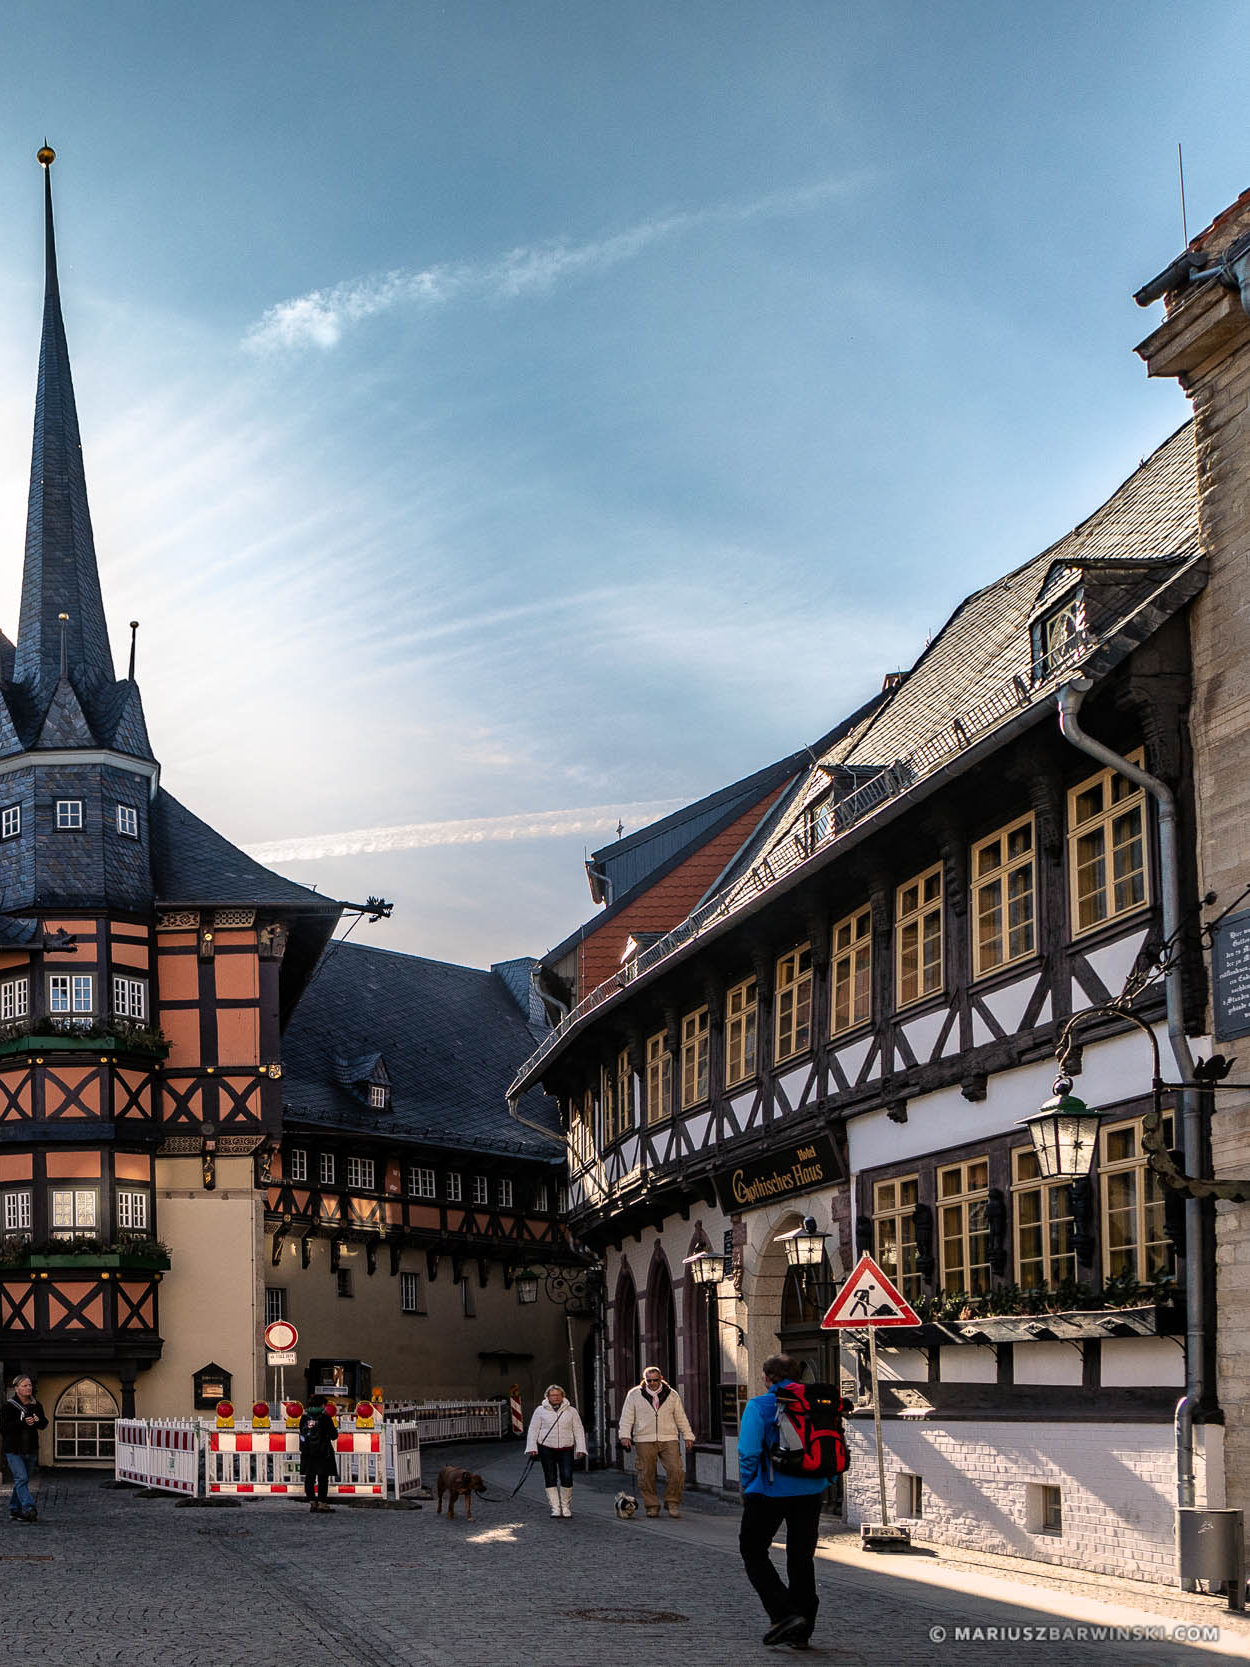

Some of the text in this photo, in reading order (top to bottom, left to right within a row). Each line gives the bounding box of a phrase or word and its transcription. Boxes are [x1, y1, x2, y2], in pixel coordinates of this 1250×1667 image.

[797, 1145, 817, 1161] Hotel
[732, 1163, 823, 1204] Gothisches Haus
